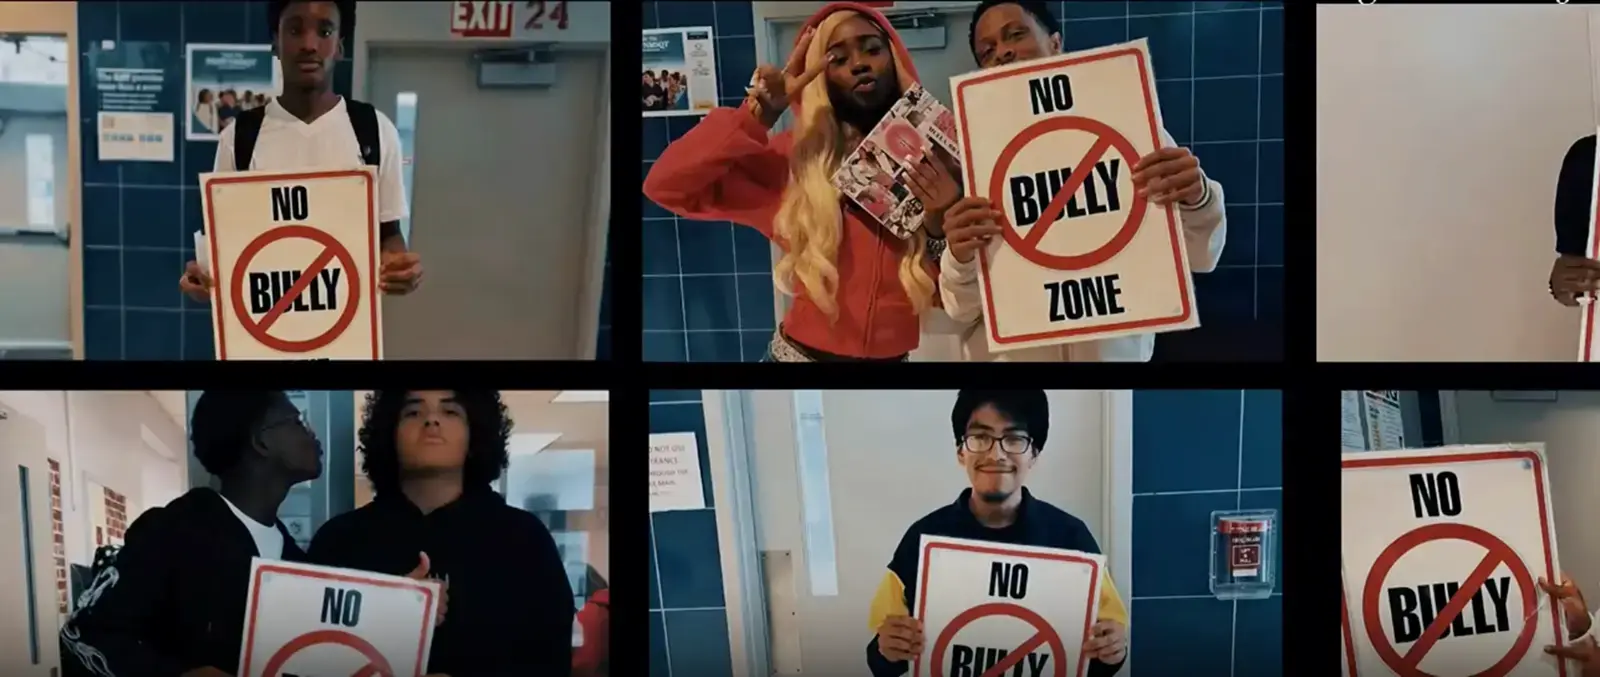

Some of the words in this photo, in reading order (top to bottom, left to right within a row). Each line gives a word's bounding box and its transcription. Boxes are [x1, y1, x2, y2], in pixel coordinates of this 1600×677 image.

[452, 1, 512, 30] EXIT
[524, 1, 568, 30] 24
[1029, 74, 1073, 115] NO
[271, 185, 309, 221] NO
[1010, 158, 1120, 227] BULLY
[249, 268, 341, 314] BULLY
[1044, 274, 1125, 322] ZONE
[1409, 471, 1462, 518] NO
[988, 561, 1029, 600] NO
[320, 587, 362, 627] NO
[1387, 576, 1511, 644] BULLY
